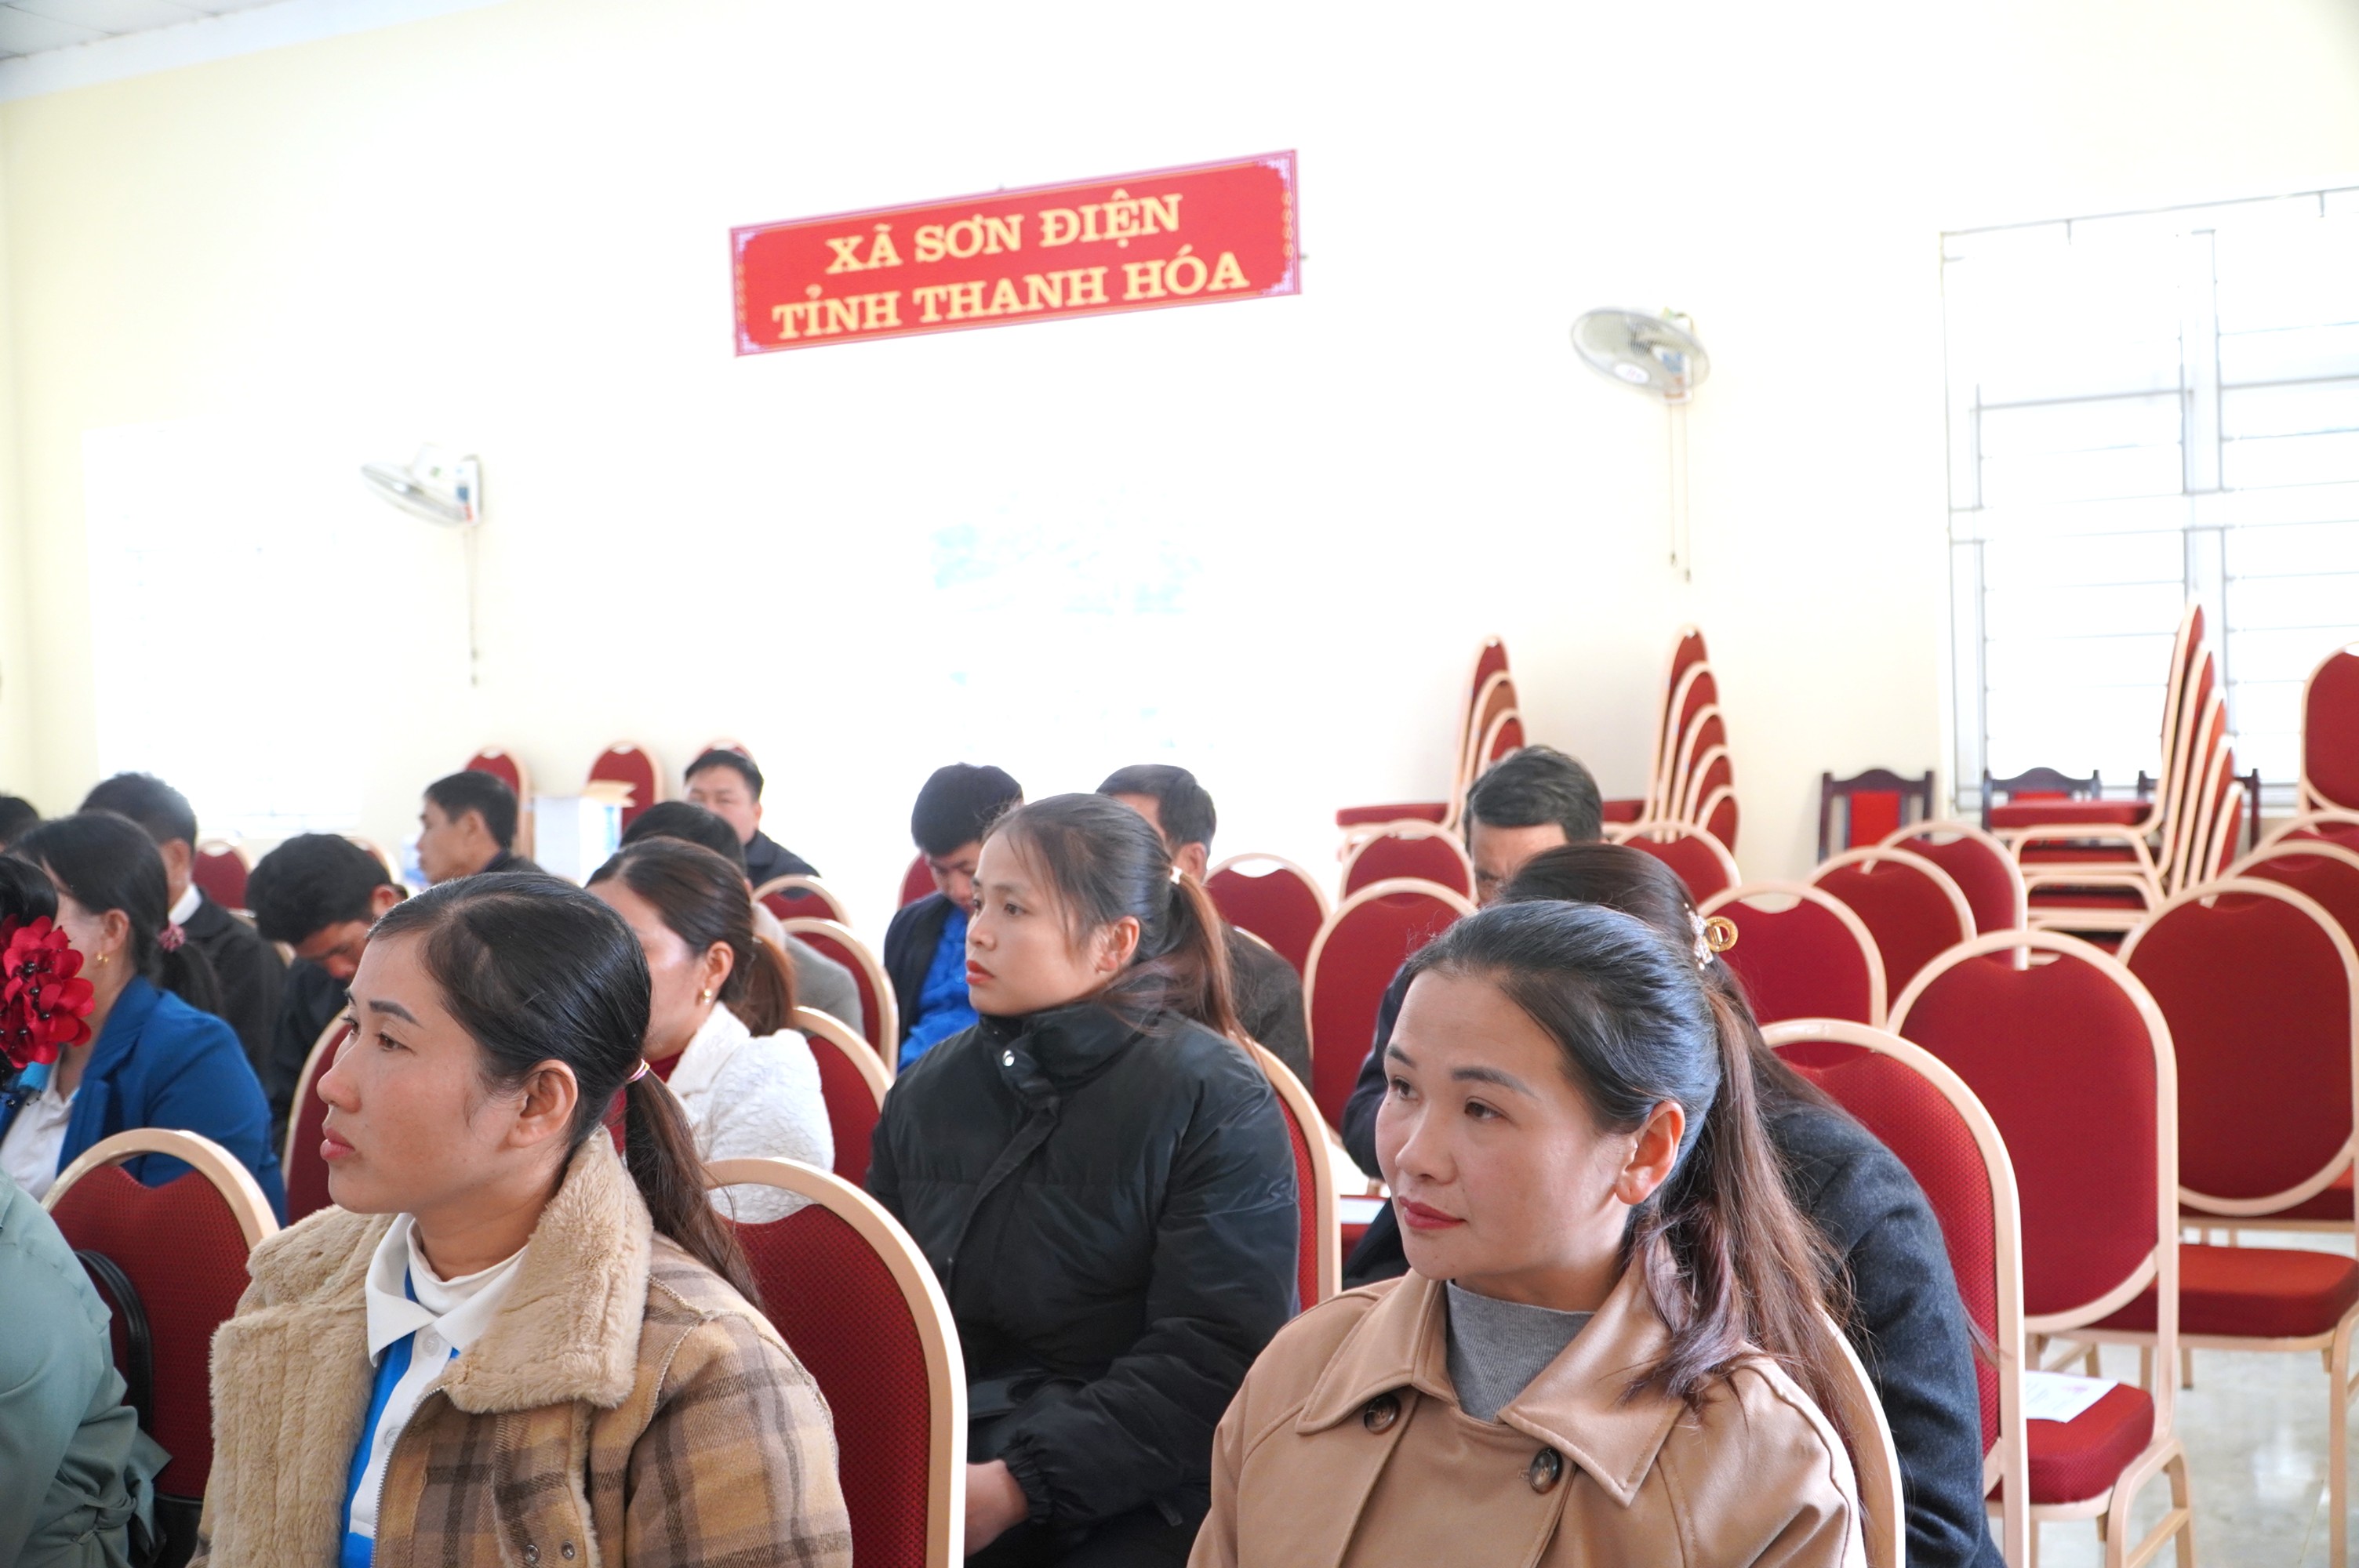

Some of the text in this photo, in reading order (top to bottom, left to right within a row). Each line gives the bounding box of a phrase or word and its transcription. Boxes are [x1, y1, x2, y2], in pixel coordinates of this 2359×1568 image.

[826, 189, 1183, 274] XÃ SƠN ĐIỆN
[772, 245, 1249, 339] TỈNH THANH HÓA
